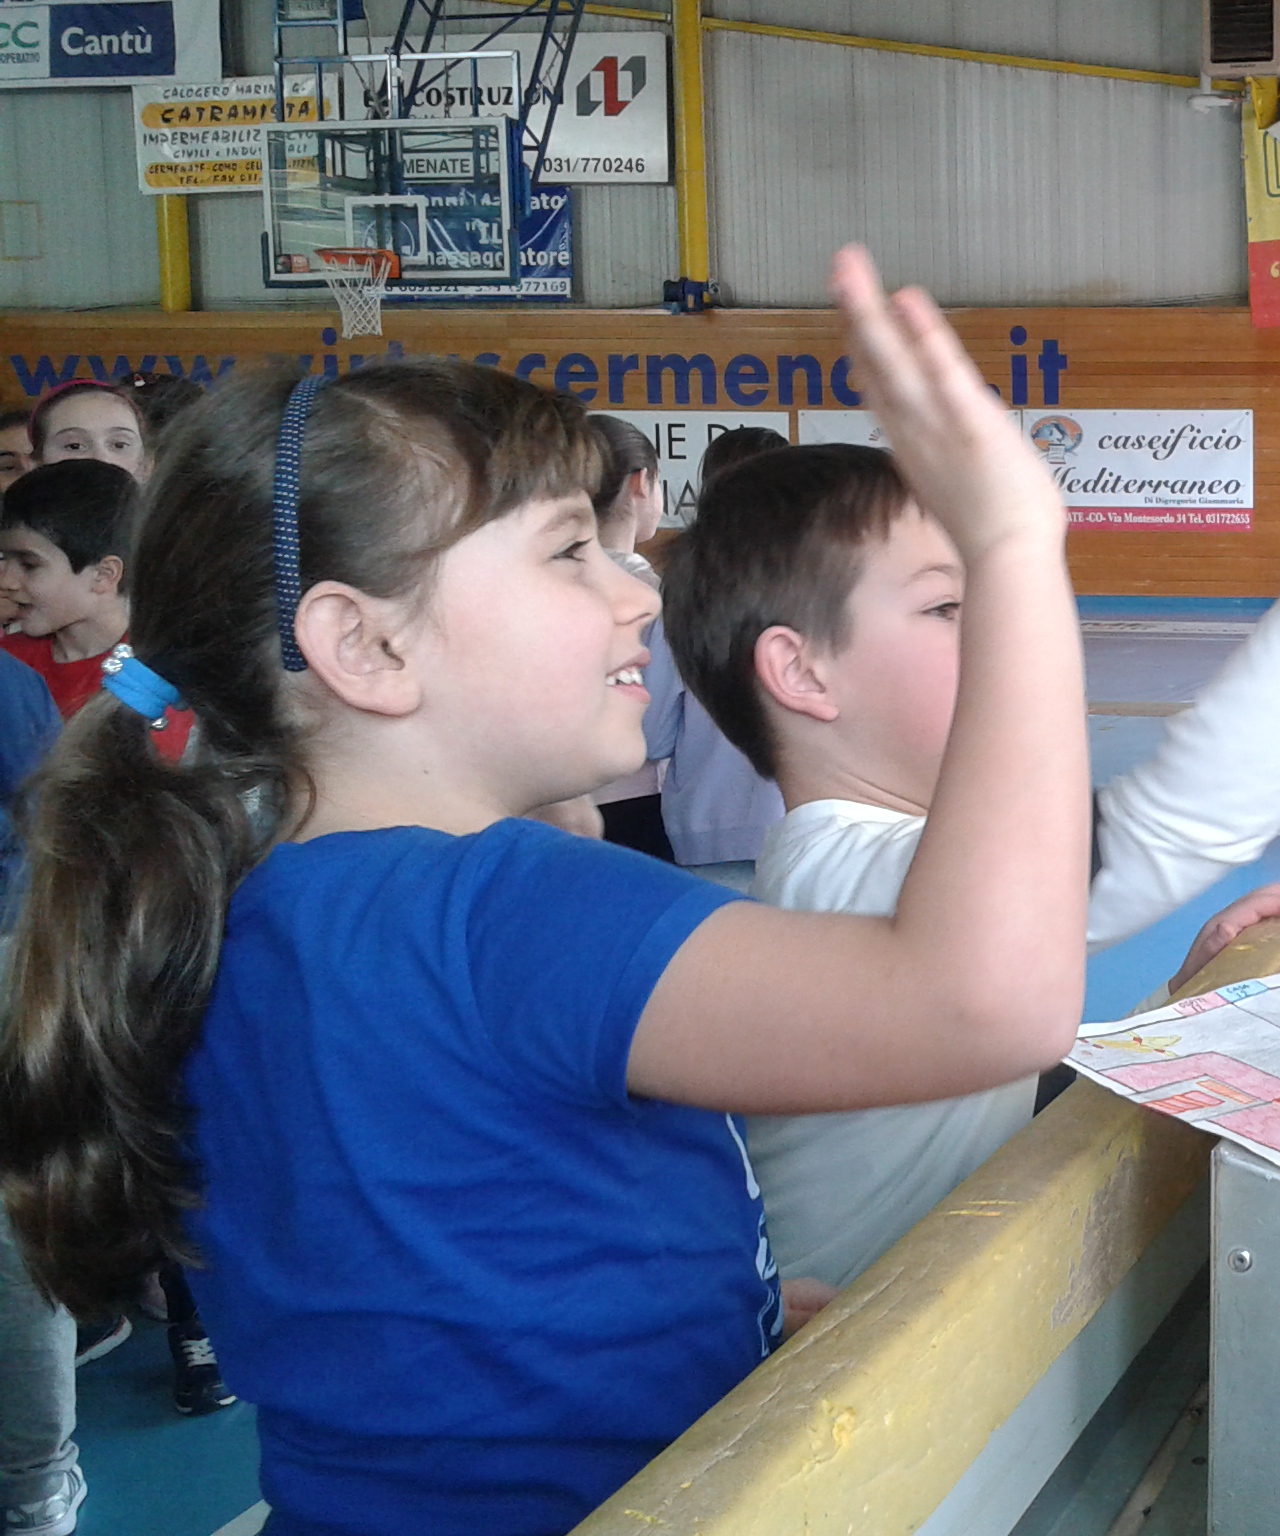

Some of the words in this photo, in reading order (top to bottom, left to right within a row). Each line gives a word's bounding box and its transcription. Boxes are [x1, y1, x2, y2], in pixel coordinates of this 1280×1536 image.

[60, 26, 153, 56] Cantù
[543, 157, 645, 173] 031/770246
[1098, 424, 1245, 460] caseificio
[1108, 513, 1122, 523] Via
[1124, 513, 1175, 524] Montesordo
[1177, 513, 1187, 524] 34
[1189, 513, 1204, 524] Tel.
